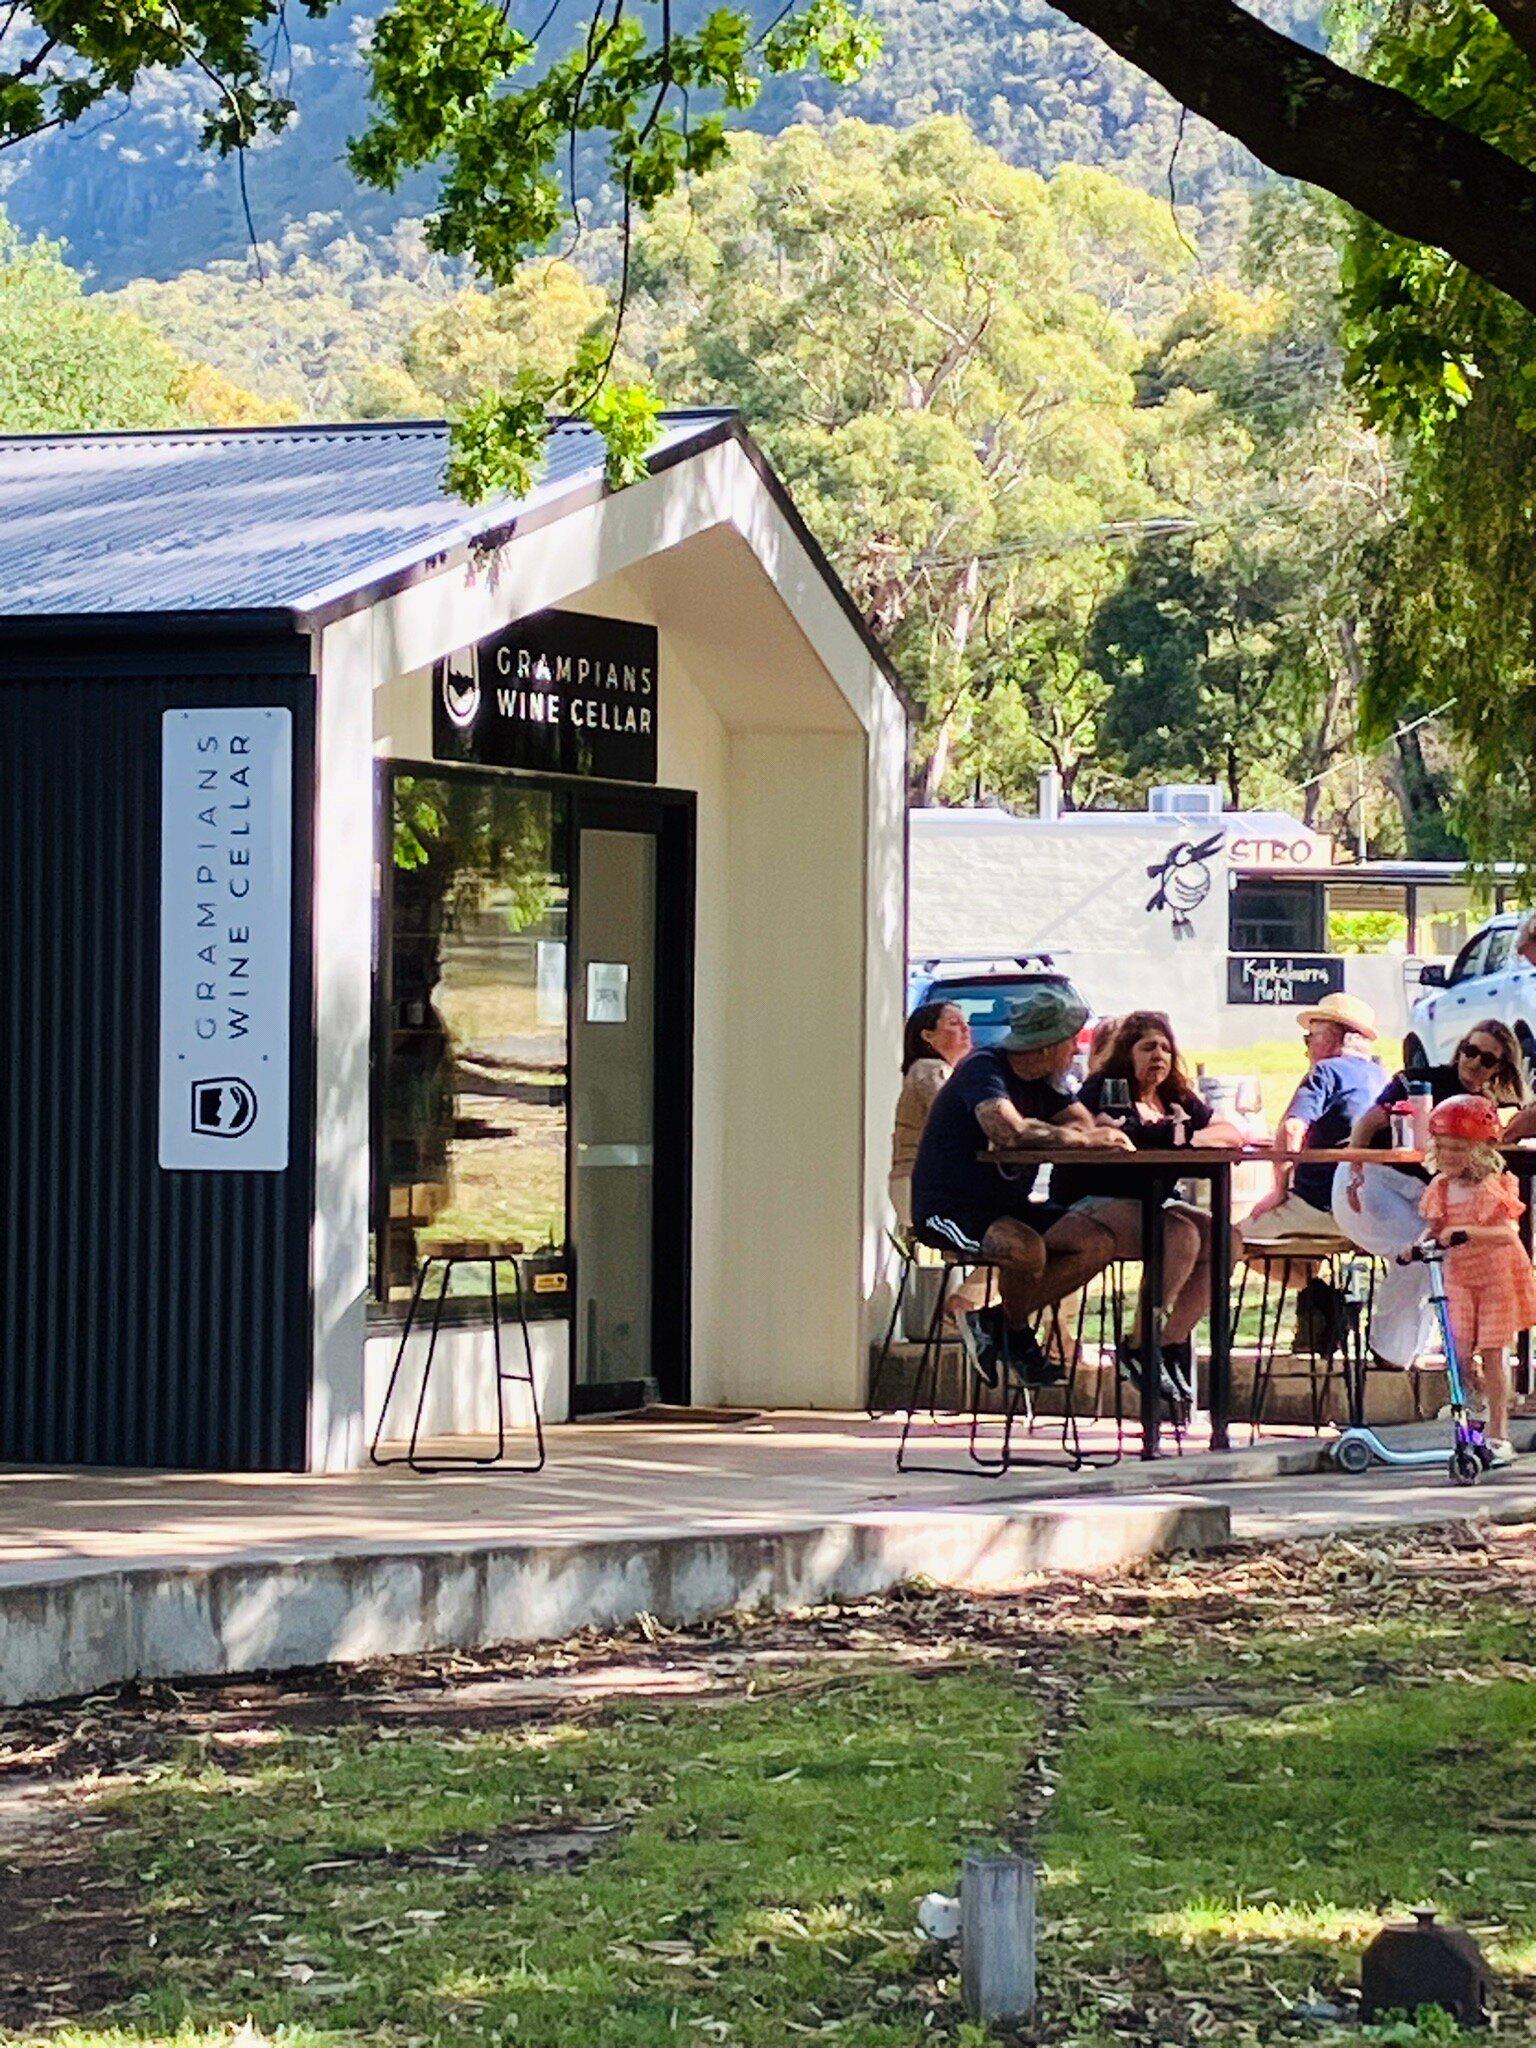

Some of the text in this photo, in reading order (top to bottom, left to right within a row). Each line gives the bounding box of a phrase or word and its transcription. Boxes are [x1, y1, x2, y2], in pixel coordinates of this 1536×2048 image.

[497, 646, 651, 694] GRAMPIANS
[497, 688, 651, 734] WINE CELLAR
[197, 736, 218, 1039] GRAMPIANS
[229, 736, 250, 1040] WINE CELLAR
[1253, 979, 1294, 1004] Hotel
